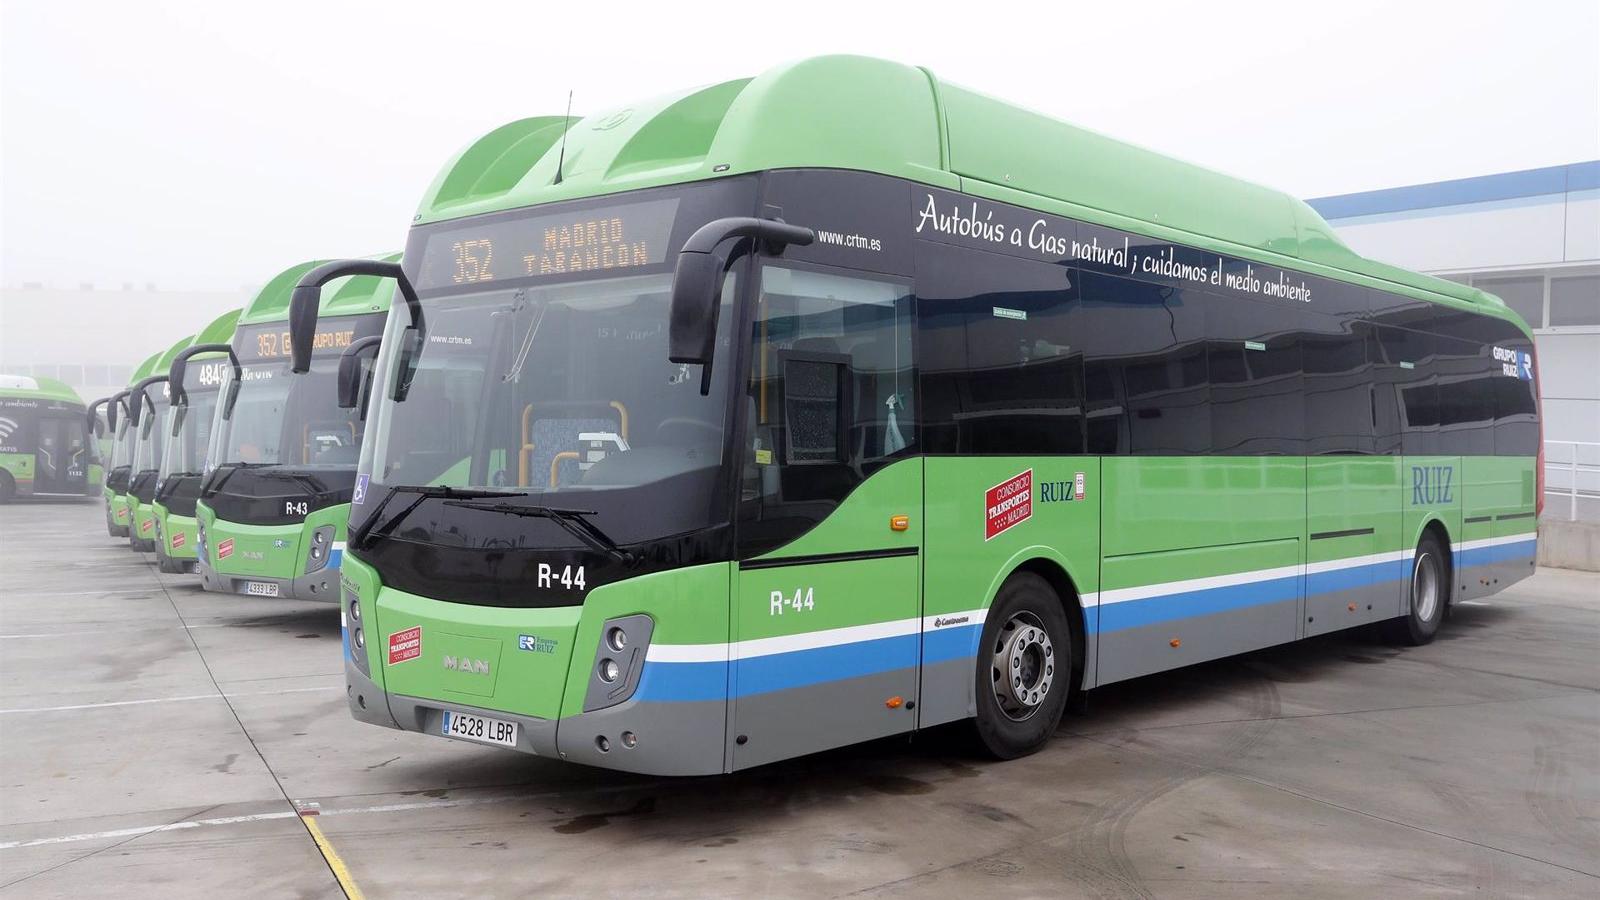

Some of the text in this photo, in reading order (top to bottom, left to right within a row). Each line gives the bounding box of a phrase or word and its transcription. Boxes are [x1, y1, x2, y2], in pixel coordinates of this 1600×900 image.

[544, 217, 623, 252] MADRID
[818, 229, 881, 251] www.crtm.es
[523, 241, 648, 277] TARANCON
[916, 194, 1004, 242] Autobús
[1010, 228, 1022, 248] a
[1028, 219, 1067, 256] Gas
[1071, 237, 1128, 268] natural
[1142, 247, 1207, 282] cuidamos
[1211, 258, 1222, 286] el
[1226, 265, 1260, 293] medio
[1263, 272, 1312, 303] ambiente
[452, 240, 494, 283] 352
[257, 333, 277, 356] 352
[430, 334, 473, 345] www.crtm.es
[1493, 346, 1516, 363] GRUPO
[200, 364, 220, 385] 484
[1503, 362, 1519, 378] RUIZ
[997, 475, 1030, 500] CONSORCIO
[1040, 481, 1074, 502] RUIZ
[1411, 466, 1453, 505] RUIZ
[286, 502, 308, 516] R-43
[988, 489, 1030, 519] TRANSPORTES
[1007, 503, 1030, 524] MADRID
[538, 563, 586, 591] R-44
[770, 587, 815, 616] R-44
[443, 655, 489, 675] MAN
[452, 716, 513, 743] 4528 LBR
